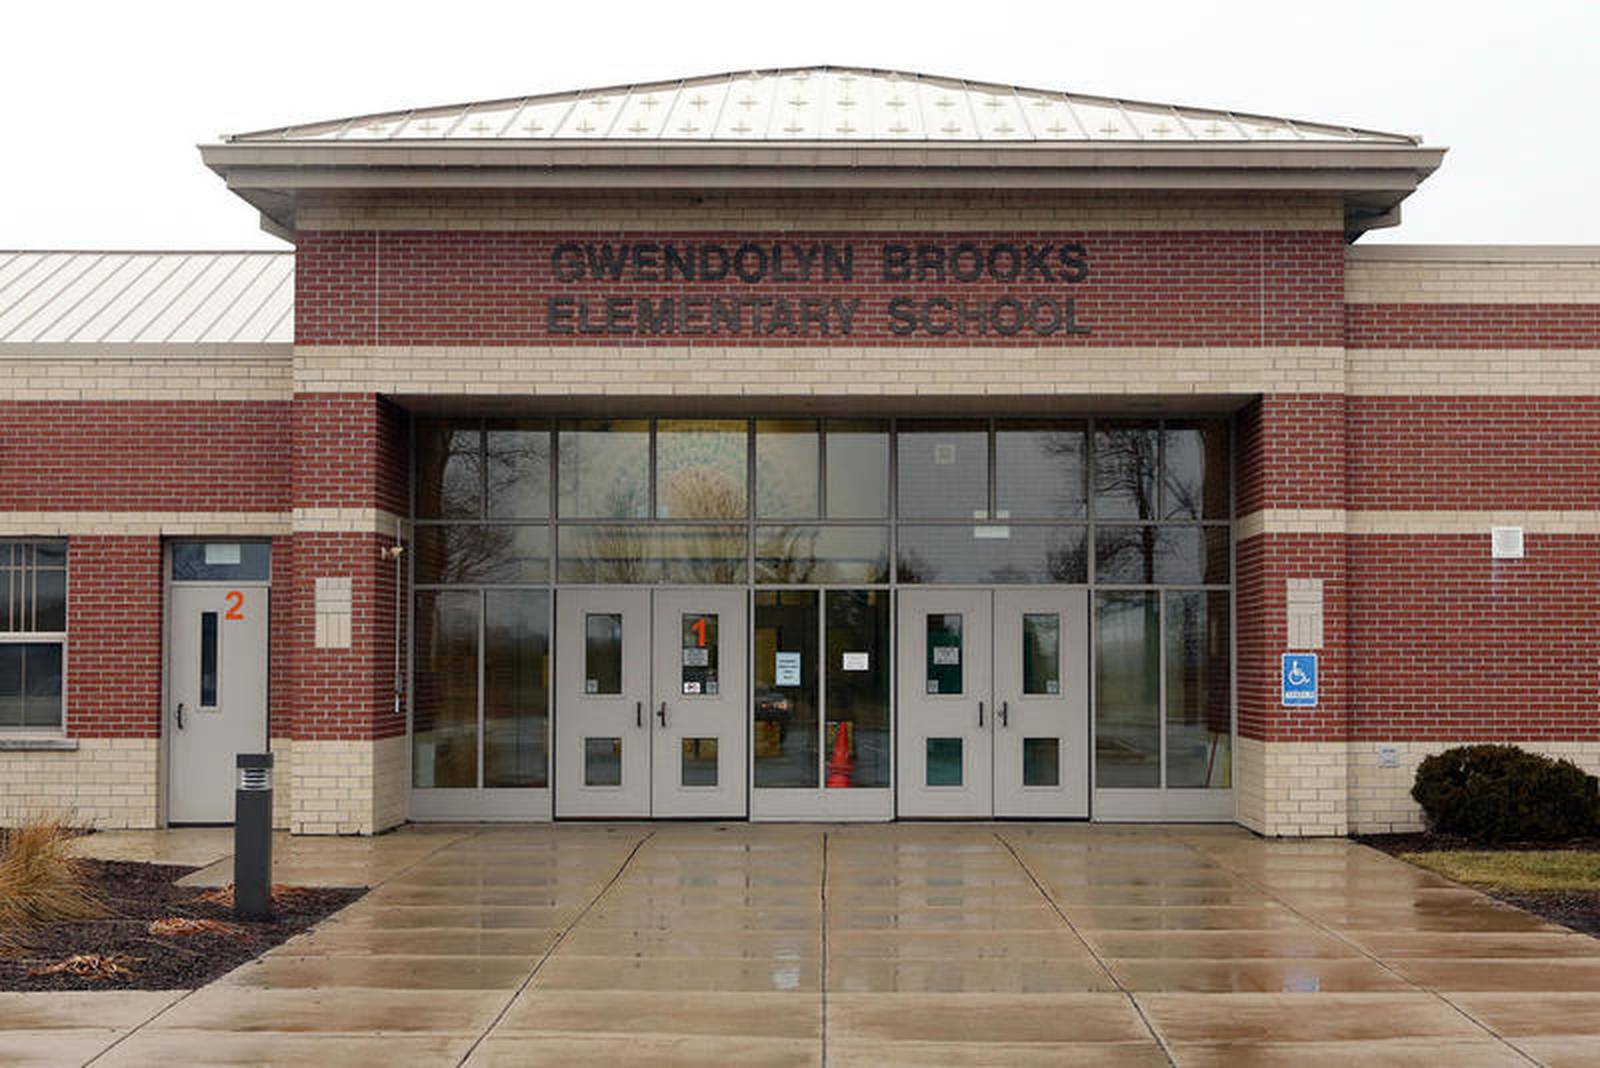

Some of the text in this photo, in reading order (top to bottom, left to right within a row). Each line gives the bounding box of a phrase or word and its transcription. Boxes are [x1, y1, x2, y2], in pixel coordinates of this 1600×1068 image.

[550, 243, 1090, 283] GWENDOLYN BROOKS
[546, 296, 1093, 336] ELEMENTARY SCHOOL
[225, 590, 245, 621] 2
[691, 618, 707, 648] 1
